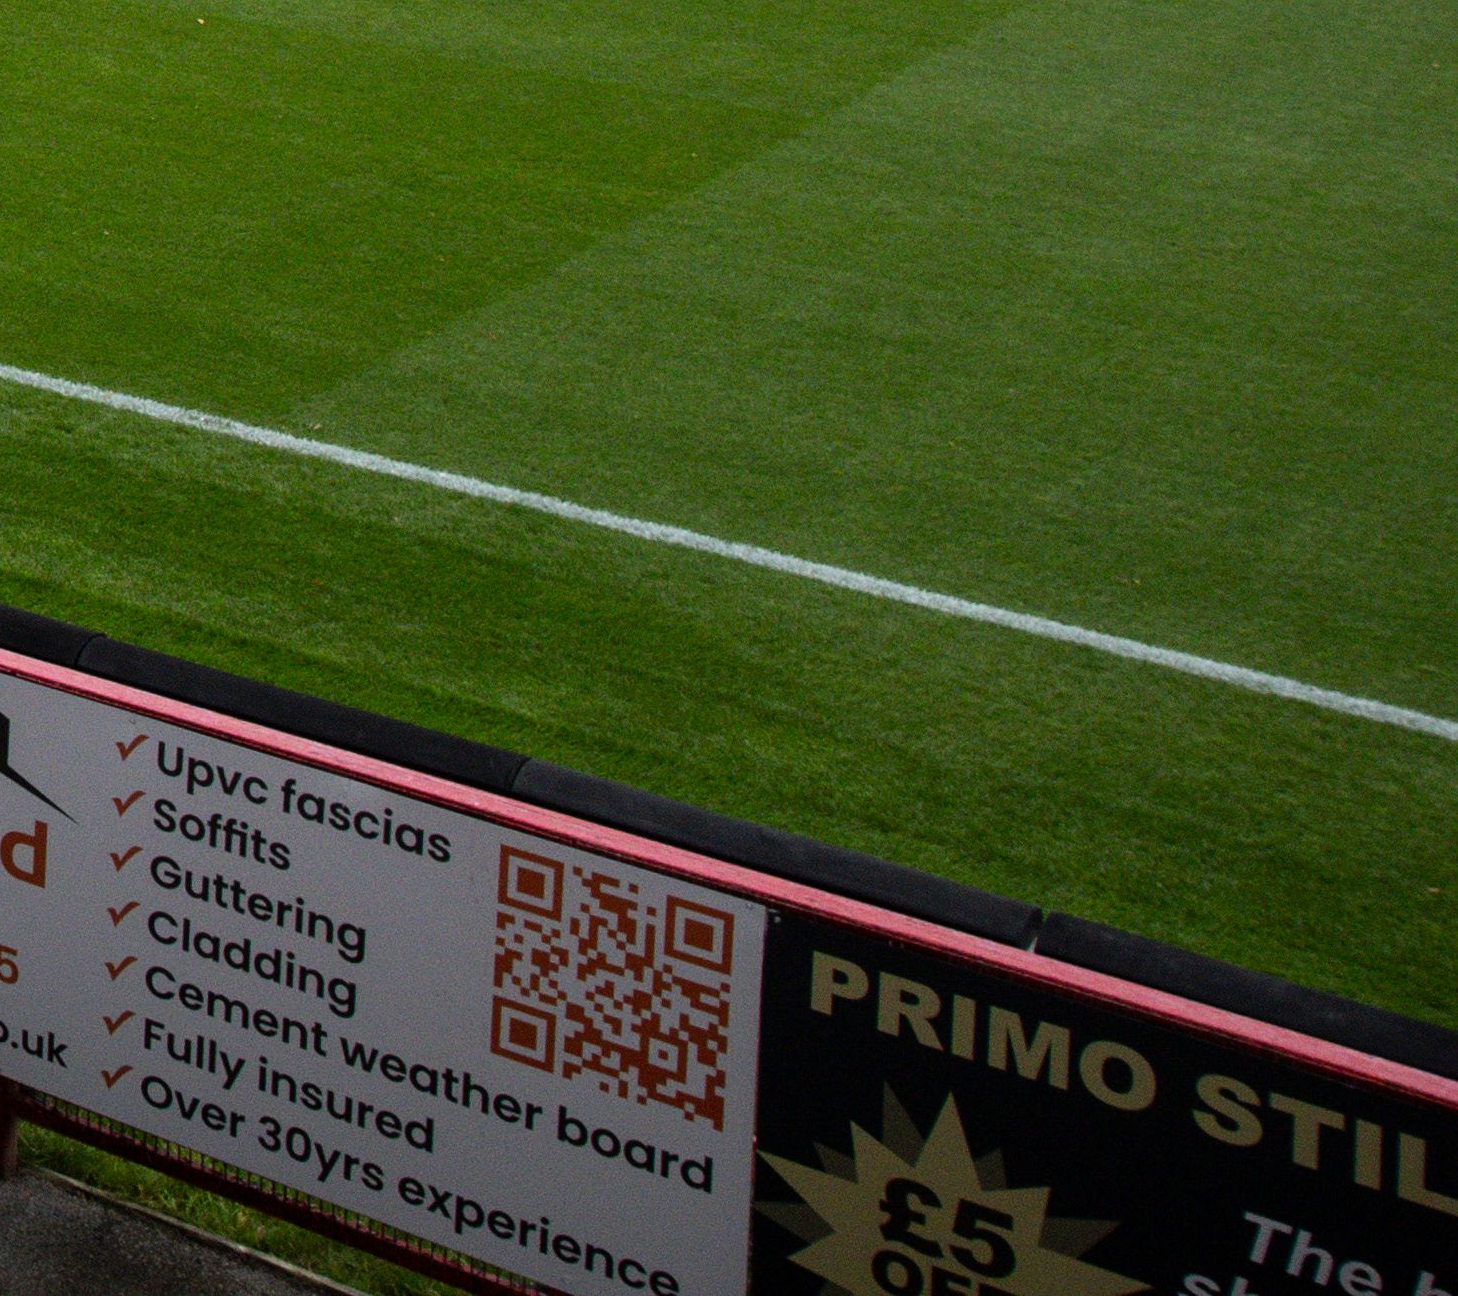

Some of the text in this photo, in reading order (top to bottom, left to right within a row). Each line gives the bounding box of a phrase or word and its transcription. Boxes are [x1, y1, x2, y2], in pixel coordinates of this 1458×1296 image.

[153, 799, 292, 872] Soffits
[155, 739, 453, 865] Upvc fascias
[146, 910, 357, 1018] Cladding
[149, 854, 367, 965] Guttering
[142, 1017, 436, 1154] Fully insured
[144, 965, 715, 1195] Cement weather board
[808, 950, 1159, 1112] PRIMO
[139, 1075, 681, 1296] Over 30yrs experience
[877, 1175, 1018, 1280] £5
